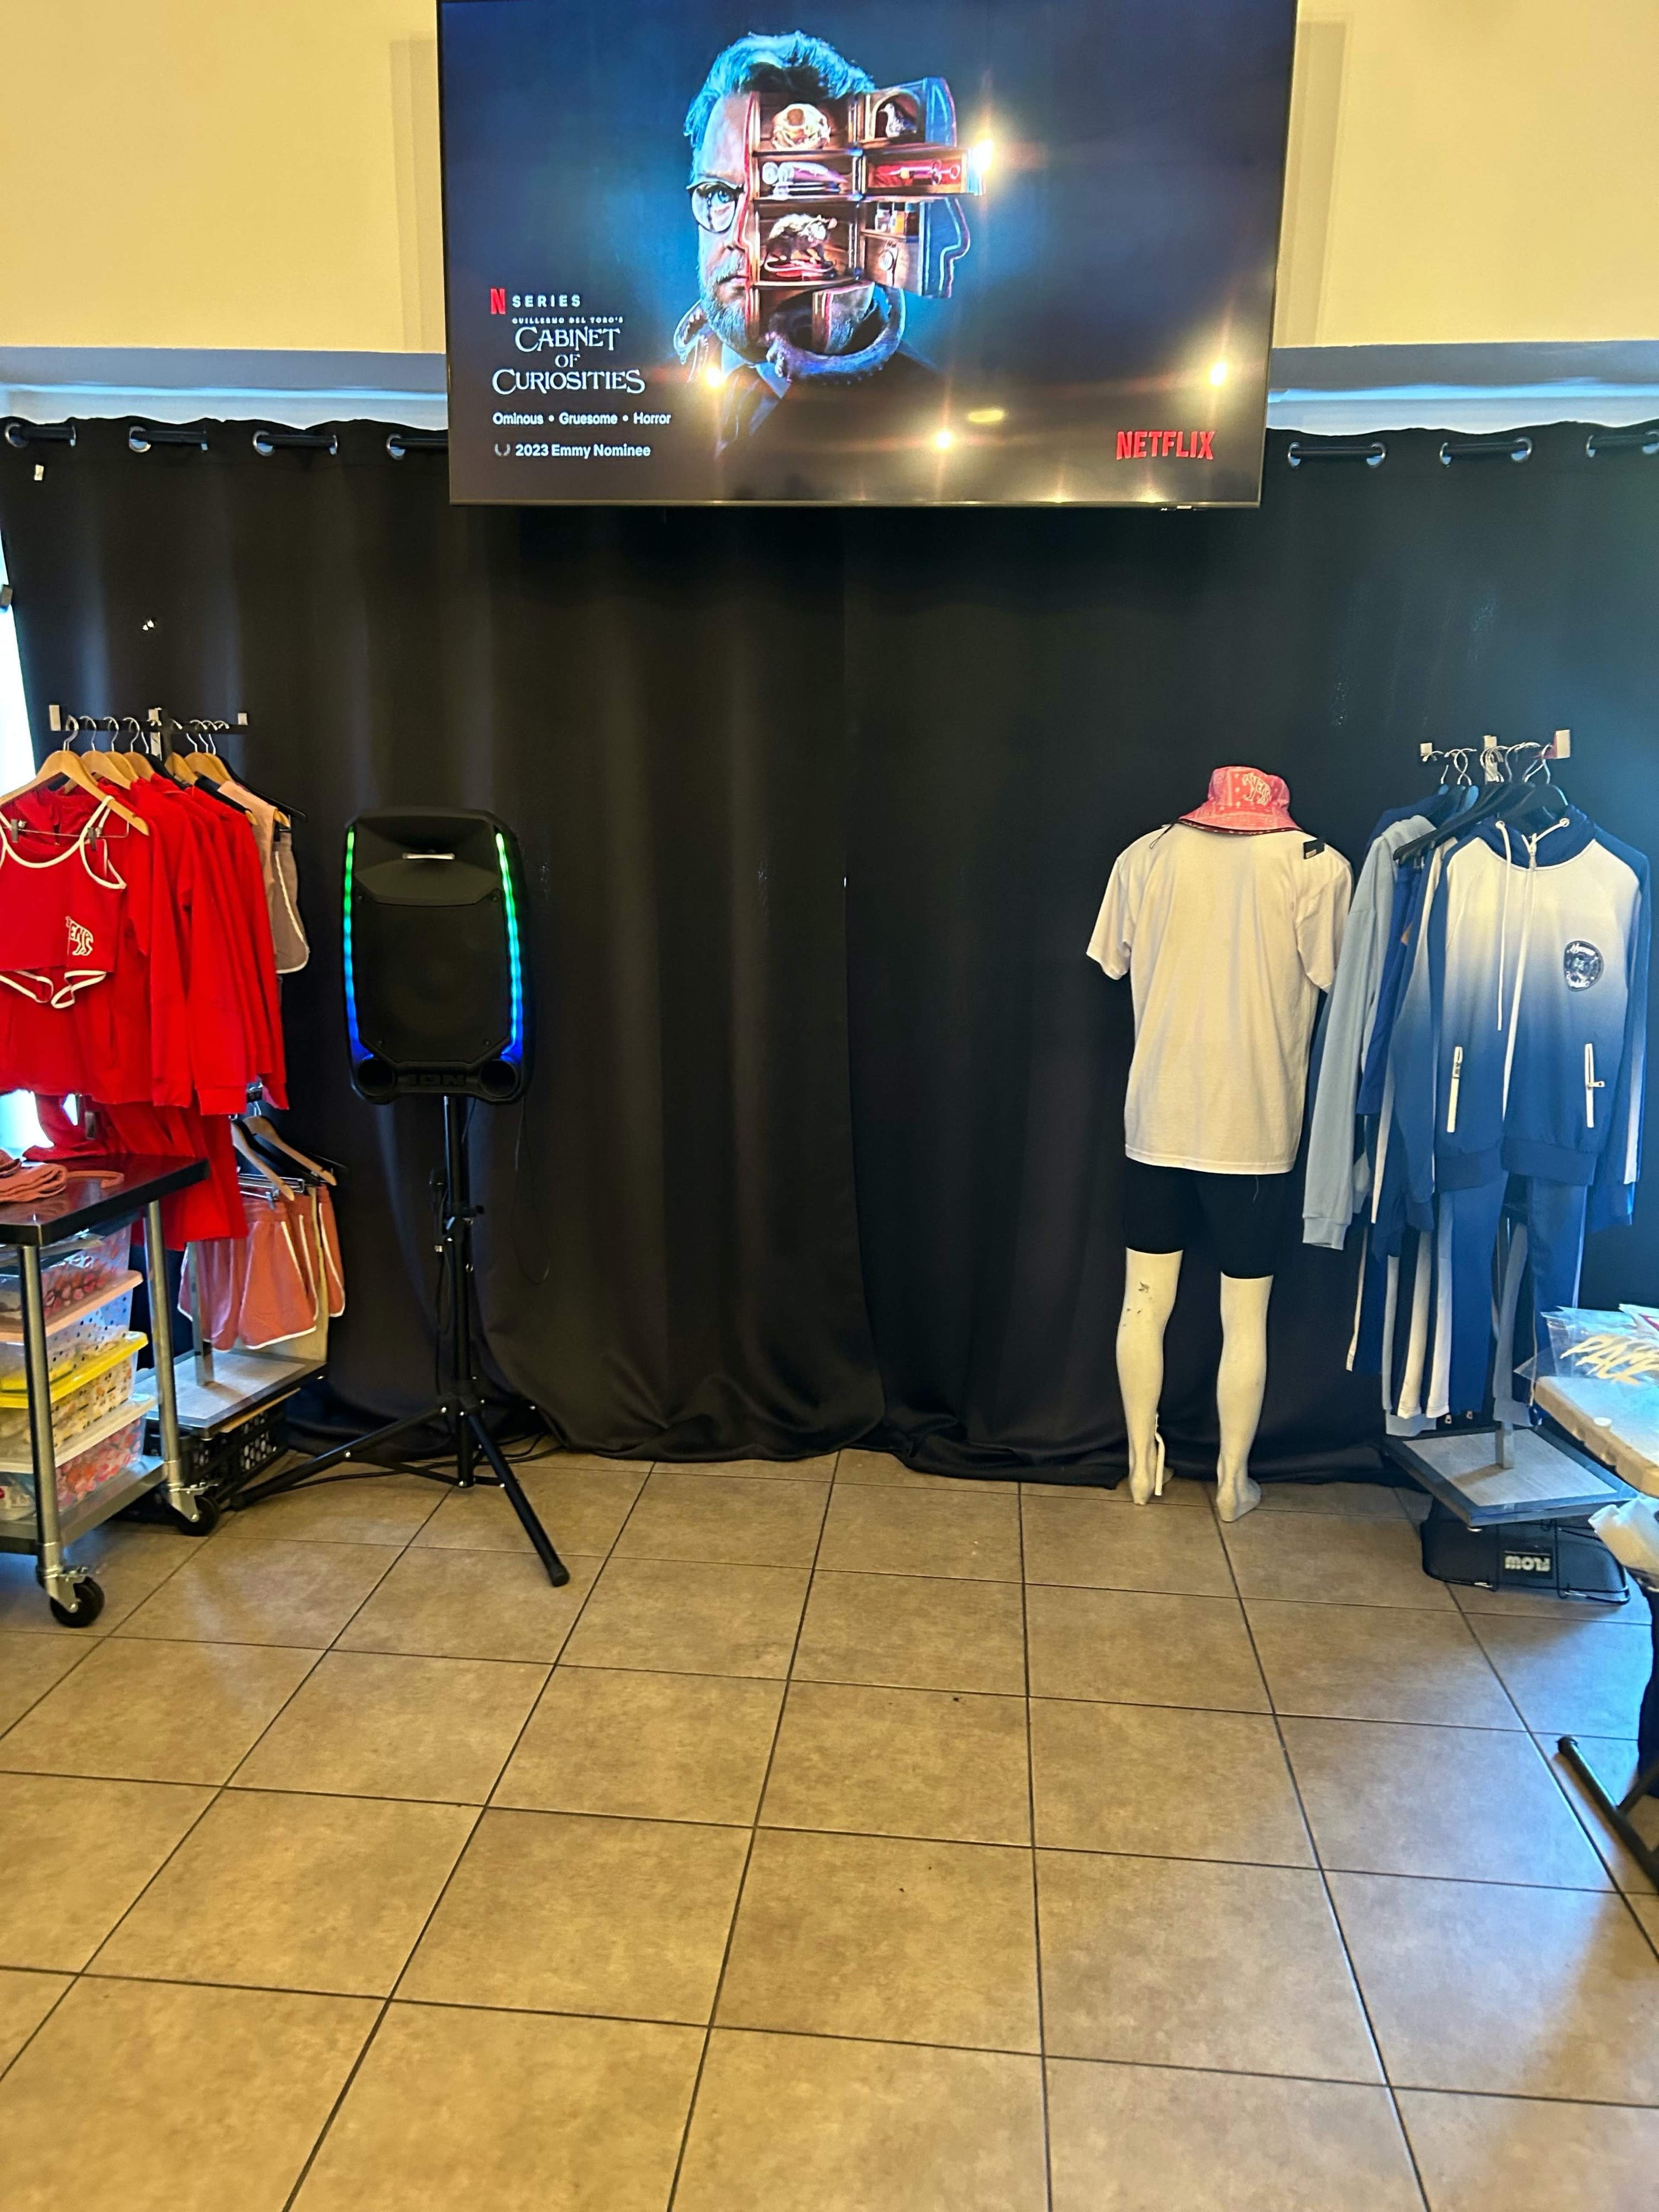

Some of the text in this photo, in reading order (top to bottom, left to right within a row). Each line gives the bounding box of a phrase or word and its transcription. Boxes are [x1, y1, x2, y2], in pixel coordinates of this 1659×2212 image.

[512, 295, 581, 307] SERIES
[515, 326, 621, 353] CABINET
[555, 353, 581, 368] OF
[492, 369, 645, 395] CURIOSITIES
[493, 412, 671, 425] Ominous Gruesome Horror
[515, 444, 651, 459] 2023 Emmy Nominee
[1116, 431, 1216, 461] NETFLIX
